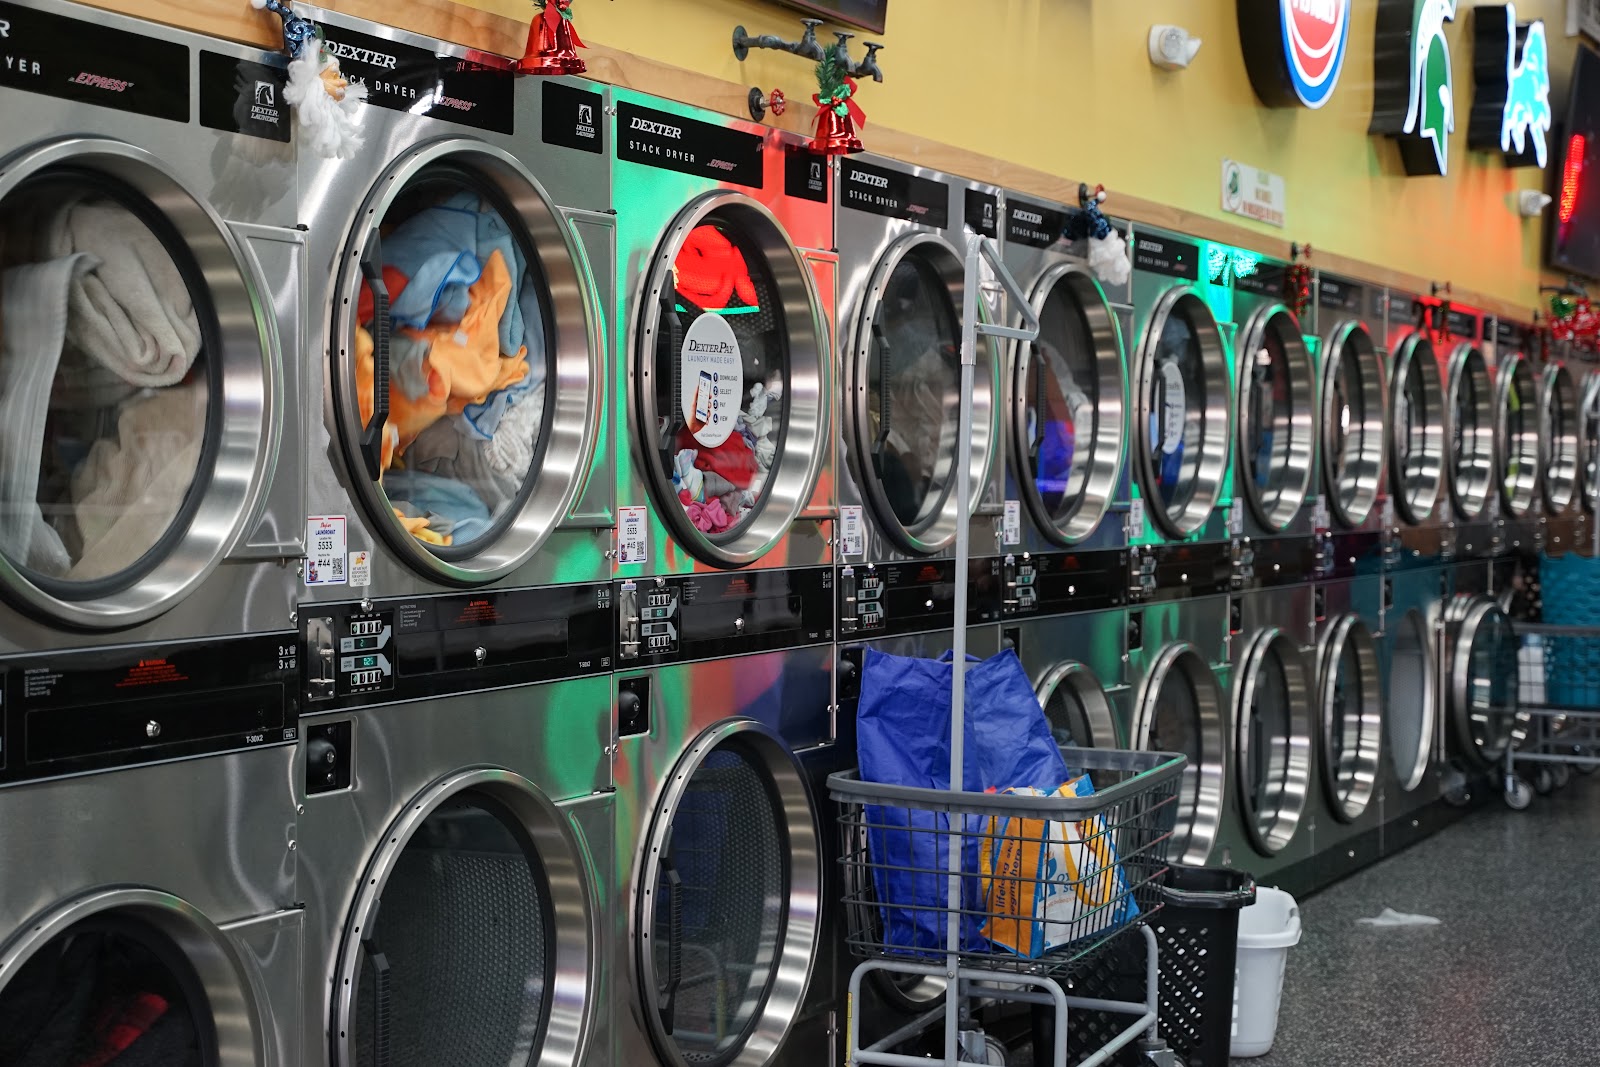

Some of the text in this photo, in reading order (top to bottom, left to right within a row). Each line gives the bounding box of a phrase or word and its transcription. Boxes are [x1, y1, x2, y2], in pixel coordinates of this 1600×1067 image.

[324, 40, 397, 70] DEXTER
[5, 55, 41, 76] YER
[74, 72, 129, 93] EXPRESS
[375, 80, 417, 99] DRYER
[251, 105, 279, 117] DEXTER
[576, 124, 595, 133] DEXTER
[629, 117, 682, 139] DEXTER
[629, 140, 695, 163] STACK DRYER
[850, 169, 889, 189] DEXTER
[849, 189, 898, 209] STACK DRYER
[1012, 208, 1042, 225] DEXTER
[688, 355, 735, 364] LAUNDRY MADE EASY
[318, 542, 332, 550] 5533
[318, 558, 330, 568] #44
[598, 601, 601, 609] 5
[279, 646, 284, 656] 3
[279, 660, 284, 670] 3
